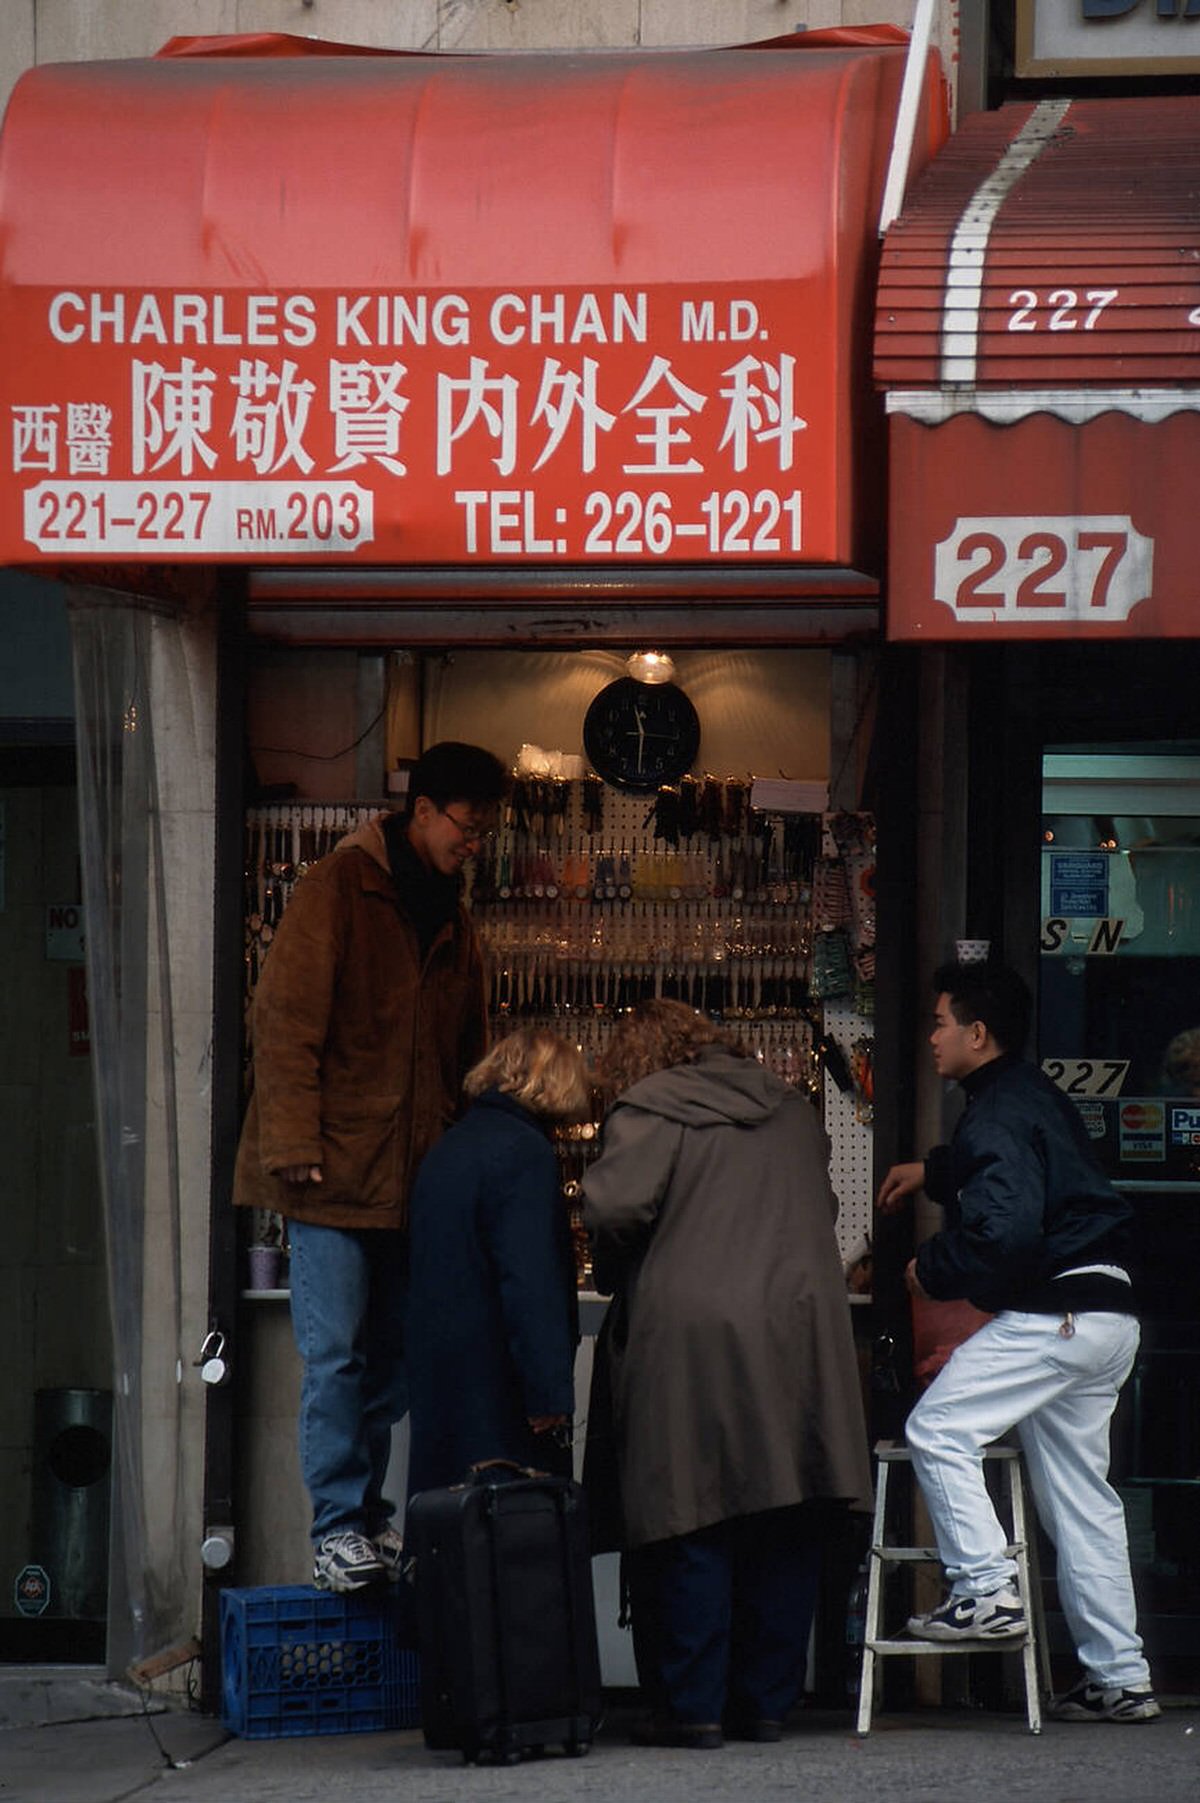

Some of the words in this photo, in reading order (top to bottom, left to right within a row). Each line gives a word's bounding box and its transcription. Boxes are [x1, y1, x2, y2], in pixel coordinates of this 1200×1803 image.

[48, 292, 317, 347] CHARLES
[336, 295, 470, 347] KING
[489, 293, 648, 346] CHAN
[681, 300, 769, 343] M.D.
[1008, 289, 1118, 331] 227
[11, 402, 113, 476] 西醫
[129, 356, 411, 477] 陳敬賢
[38, 491, 213, 541] 221-227
[236, 492, 361, 541] RM.203
[455, 490, 567, 554] TEL:
[584, 490, 802, 554] 226-1221
[955, 531, 1129, 609] 227
[50, 908, 79, 929] NO
